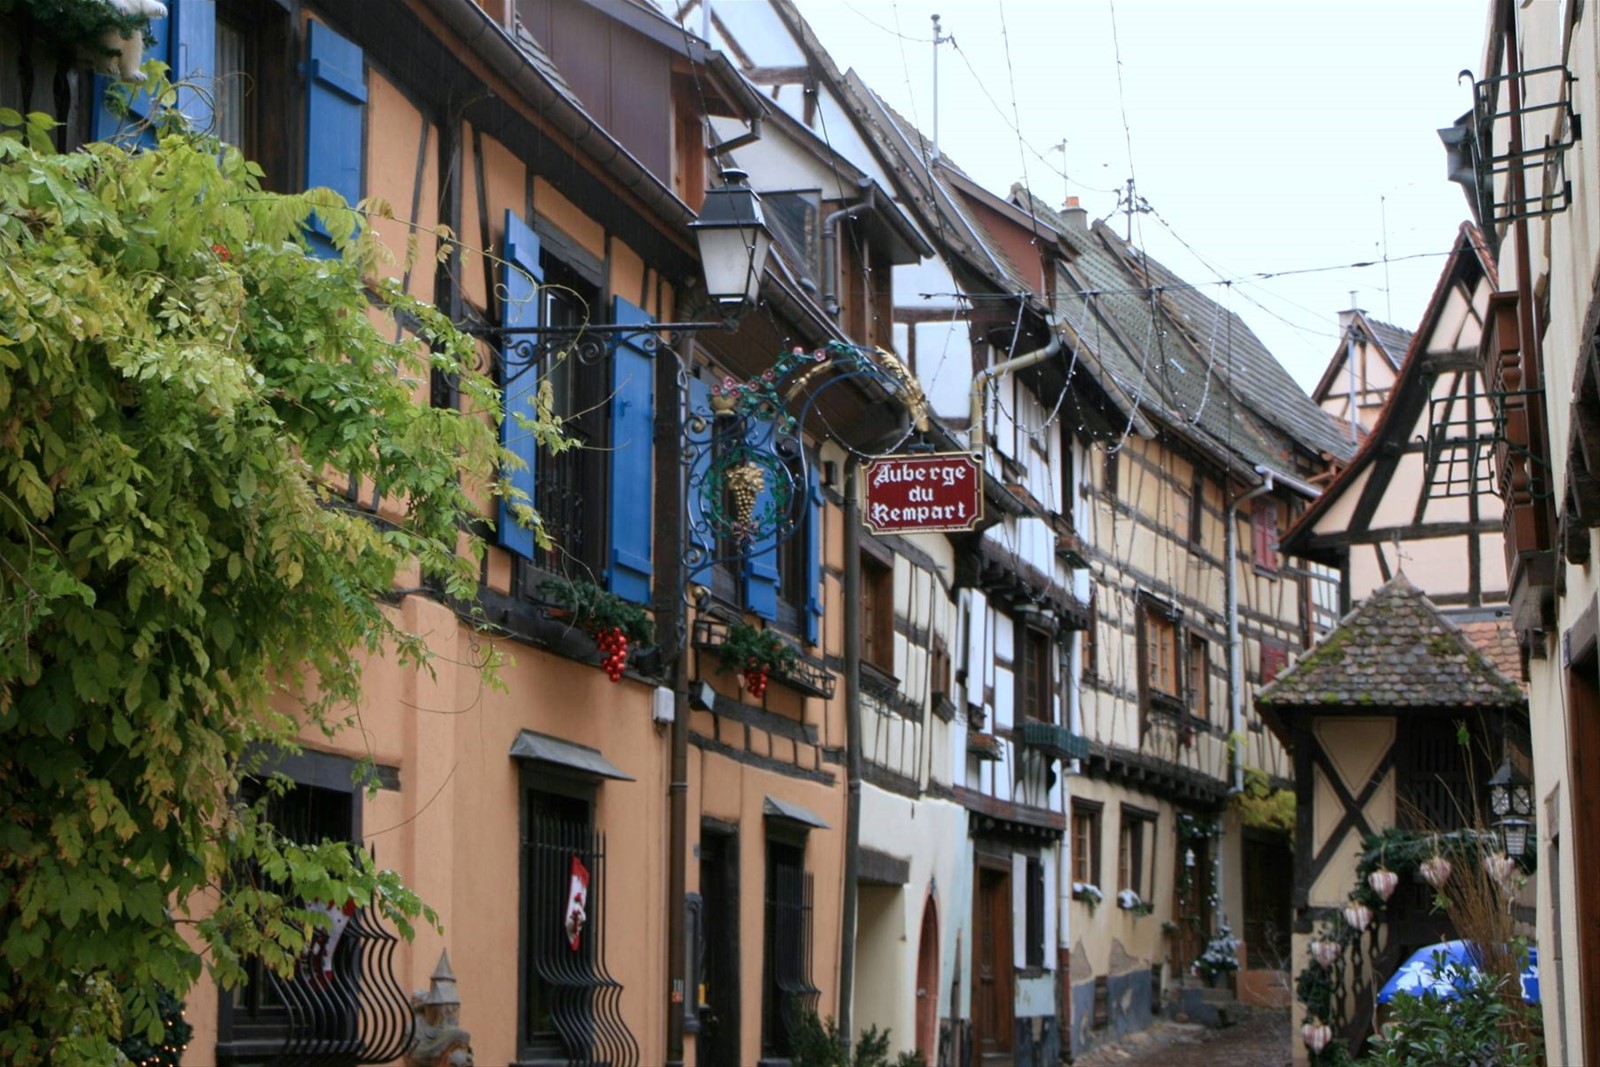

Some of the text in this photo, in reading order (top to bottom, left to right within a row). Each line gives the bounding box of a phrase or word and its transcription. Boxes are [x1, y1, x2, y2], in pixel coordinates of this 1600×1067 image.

[873, 463, 966, 488] Auberge
[908, 485, 934, 502] du
[872, 502, 966, 526] Rempart
